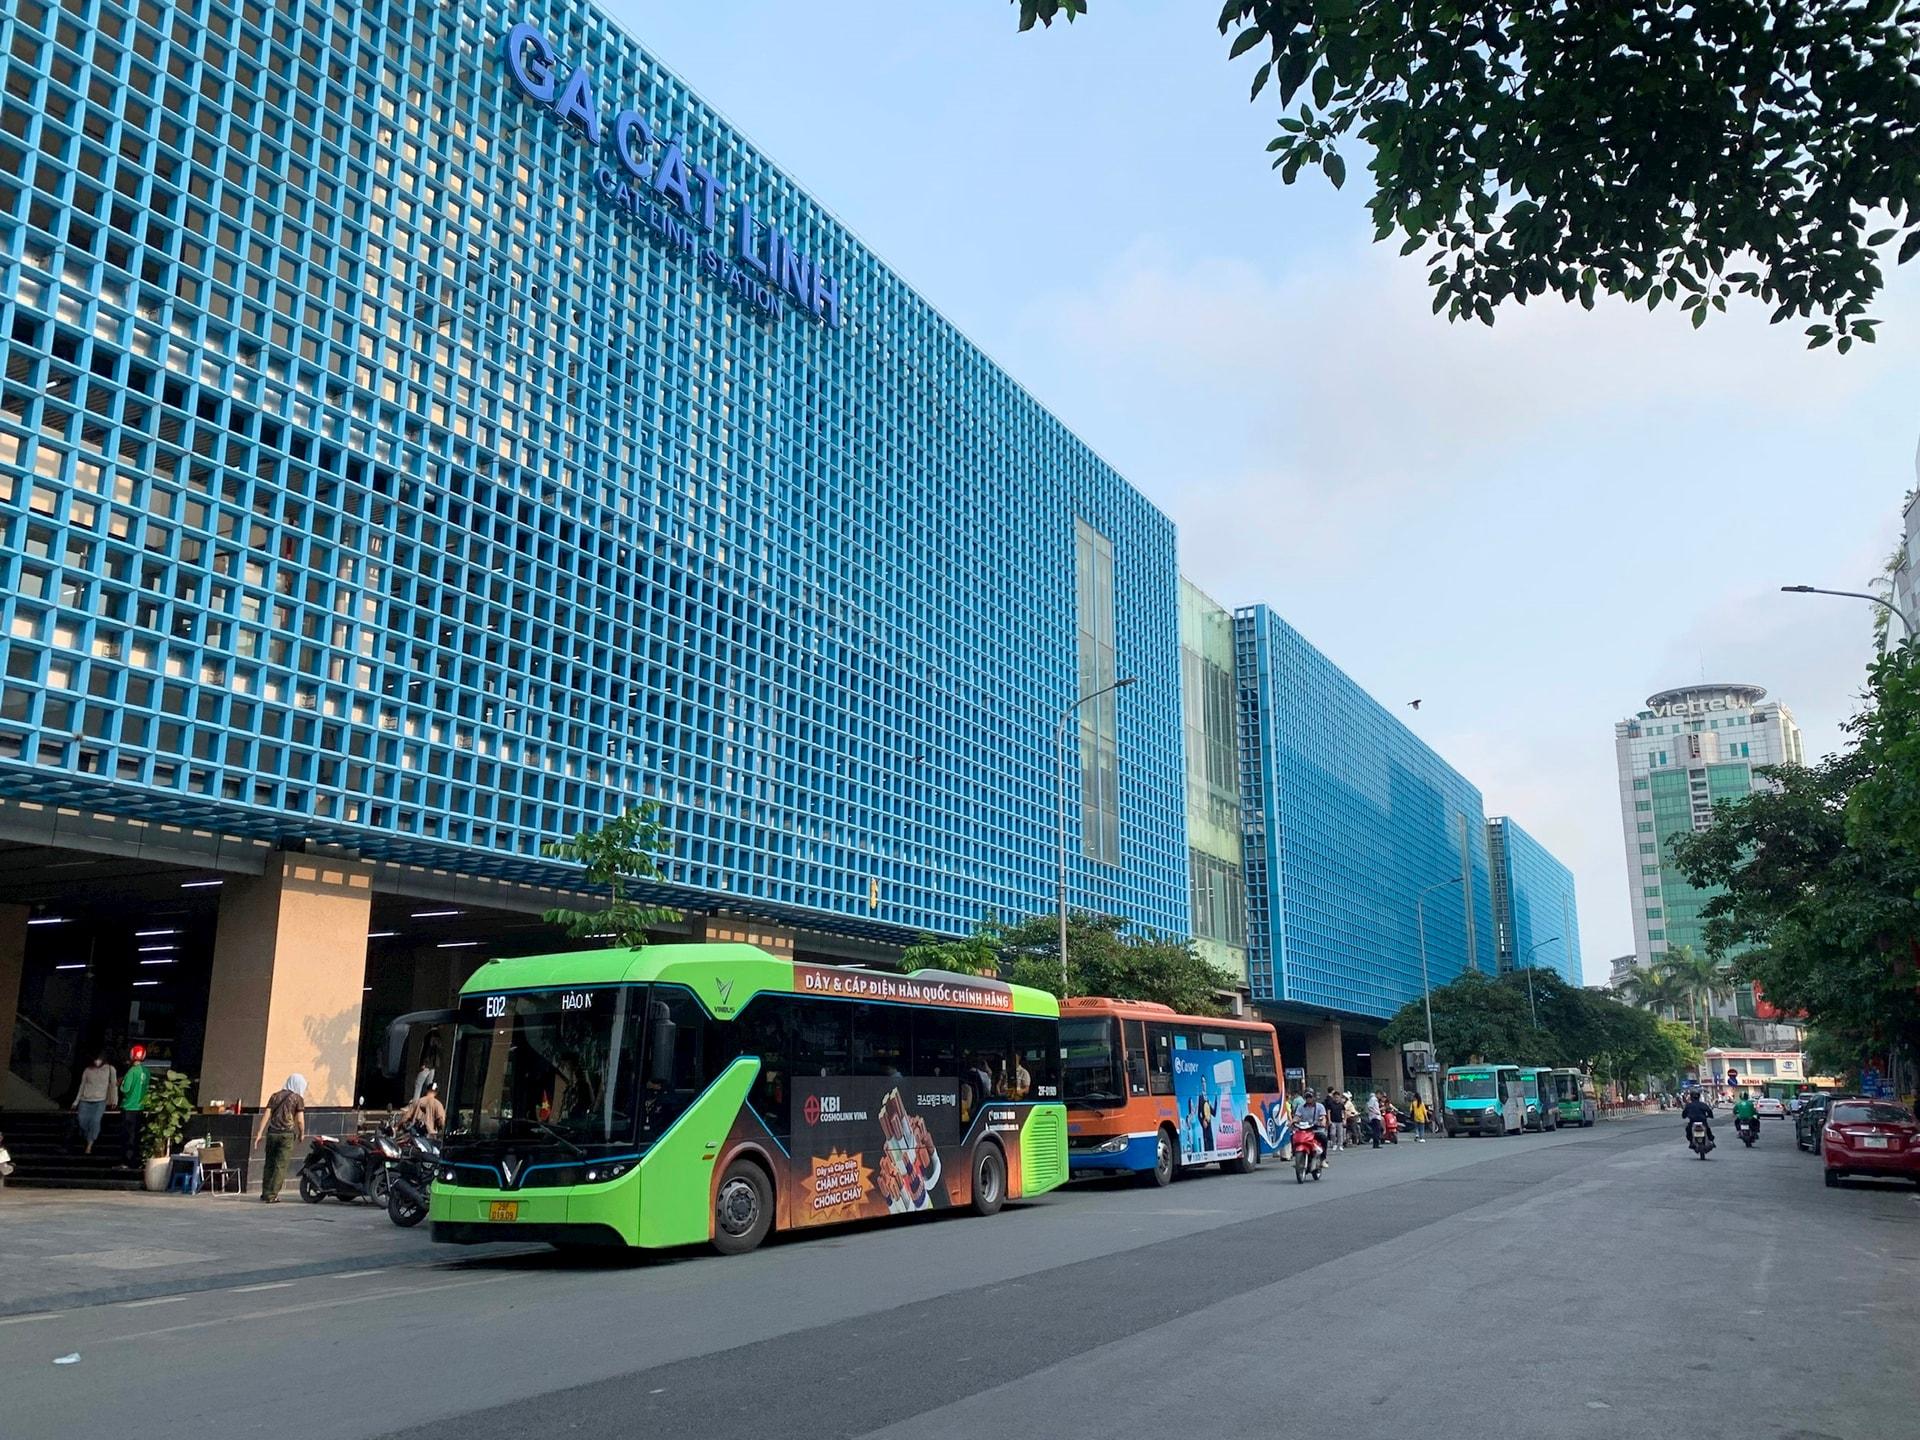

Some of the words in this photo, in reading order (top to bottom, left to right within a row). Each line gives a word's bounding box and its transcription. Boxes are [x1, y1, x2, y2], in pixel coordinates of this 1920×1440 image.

[505, 22, 600, 147] GA
[615, 111, 725, 234] CÁT
[739, 202, 839, 329] LINH
[594, 167, 646, 216] CAT
[651, 204, 698, 254] LINH
[704, 247, 783, 321] STATION
[805, 971, 831, 990] DÂY
[833, 977, 842, 992] &
[845, 976, 867, 994] CÁP
[869, 979, 896, 998] ĐIỆN
[899, 982, 920, 998] HÀN
[923, 984, 950, 1003] QUỐC
[952, 988, 982, 1005] CHÍNH
[486, 996, 506, 1017] E02
[562, 991, 583, 1010] HÀO
[820, 1096, 841, 1113] KBI
[820, 1112, 853, 1122] COSMOLINK
[854, 1111, 868, 1121] VINA
